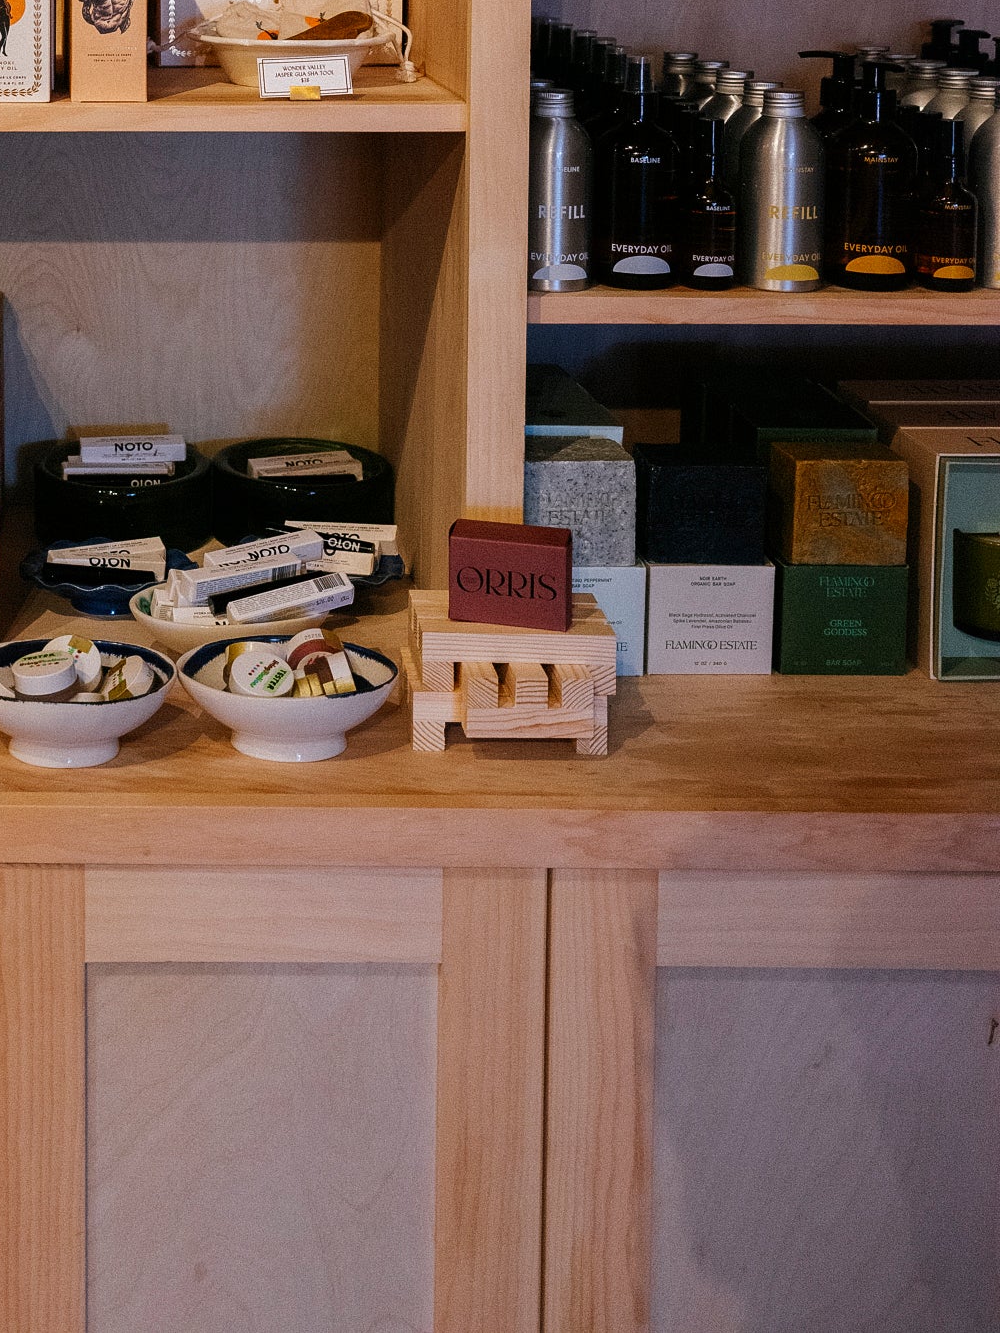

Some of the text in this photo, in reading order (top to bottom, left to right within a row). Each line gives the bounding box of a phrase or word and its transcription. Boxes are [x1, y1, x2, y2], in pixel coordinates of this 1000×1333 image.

[630, 156, 661, 164] BASELINE
[539, 204, 586, 220] REFILL
[767, 204, 818, 220] REFILL
[611, 243, 673, 254] EVERYDAY OIL
[844, 242, 908, 254] EVERYDAY OIL
[692, 254, 727, 262] EVERYDAY
[931, 256, 968, 265] EVERYDAY
[114, 441, 154, 453] NOTO
[285, 458, 323, 468] NOTO
[807, 492, 897, 511] FLAMINGO
[819, 511, 885, 528] ESTATE
[328, 537, 361, 552] NOTO
[248, 544, 290, 563] NOTO
[89, 557, 131, 568] NOTO
[456, 566, 557, 601] ORRIS
[819, 576, 875, 587] FLAMINGO
[826, 587, 867, 598] ESTATE
[829, 619, 862, 627] GREEN
[823, 628, 868, 637] GODDESS
[665, 640, 758, 651] FLAMINGO ESTATE
[267, 669, 288, 691] TESTER
